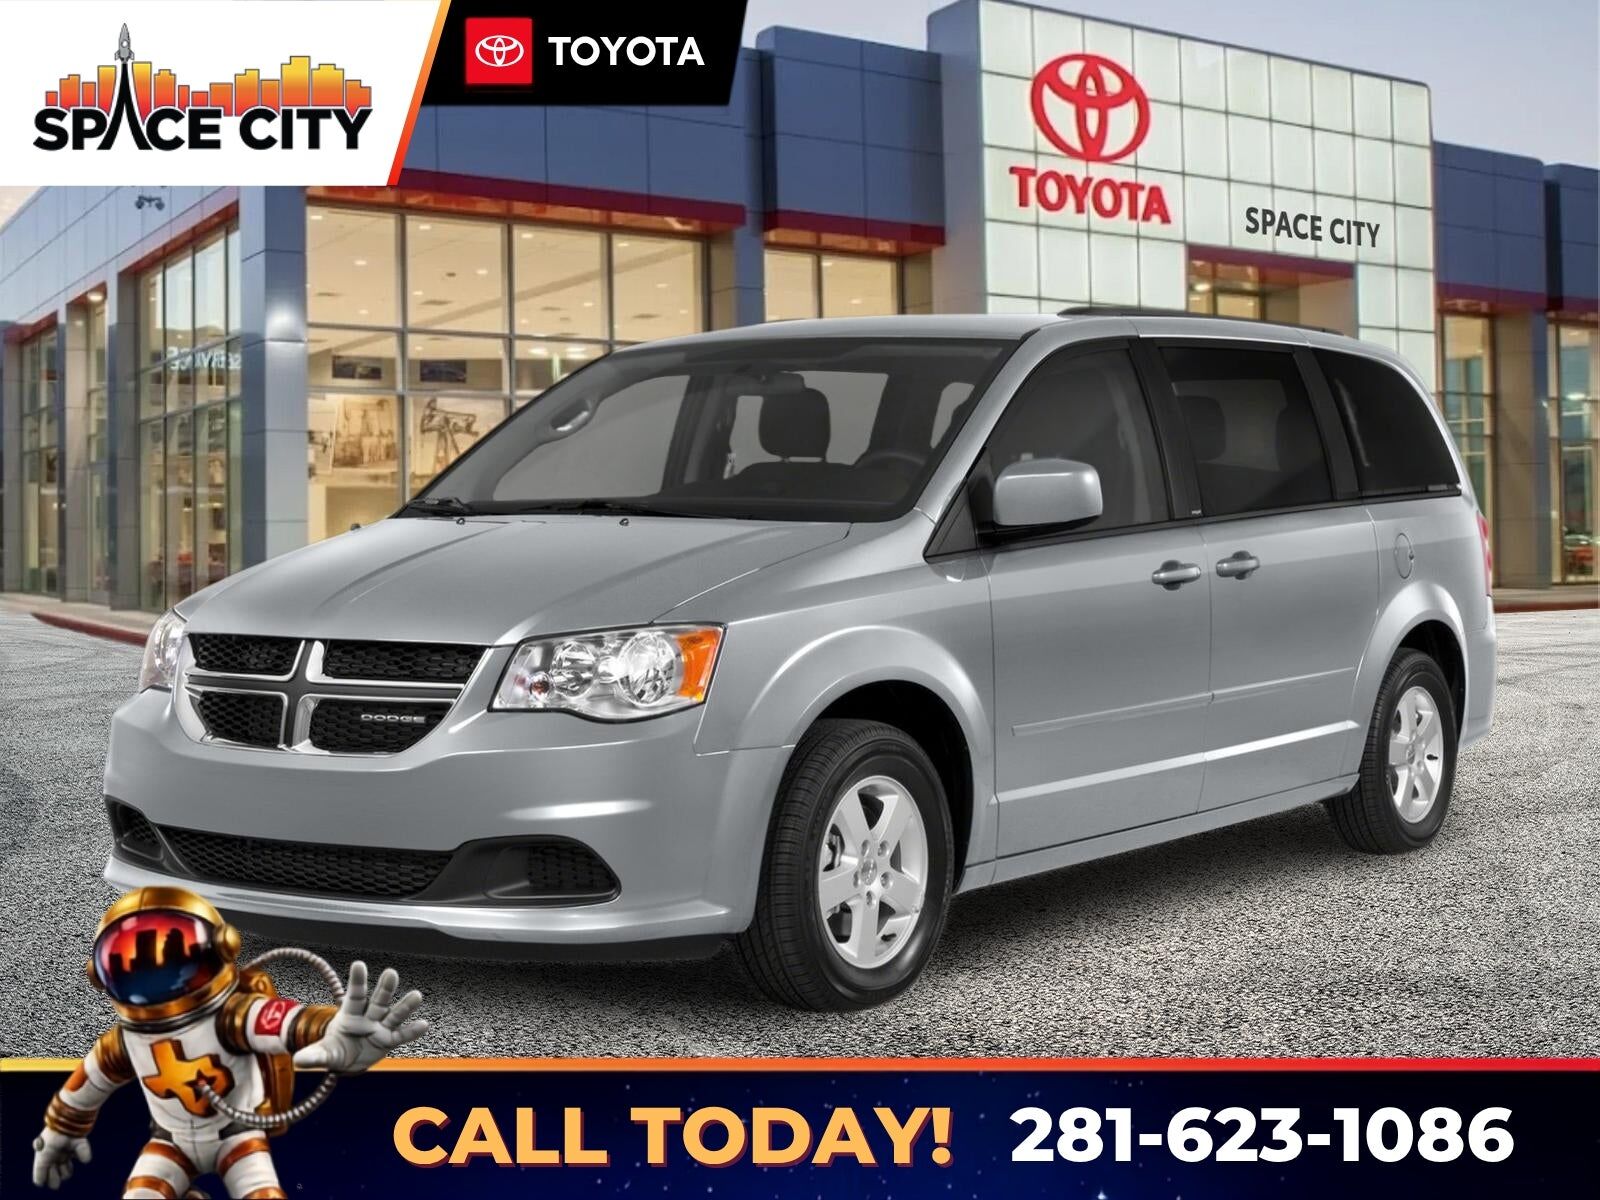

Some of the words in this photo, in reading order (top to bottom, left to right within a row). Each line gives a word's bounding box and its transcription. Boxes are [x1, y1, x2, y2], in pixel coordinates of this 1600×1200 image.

[1009, 166, 1171, 224] TOYOTA
[1245, 206, 1322, 241] SPACE
[1329, 218, 1381, 248] CITY
[360, 714, 425, 723] DODGE
